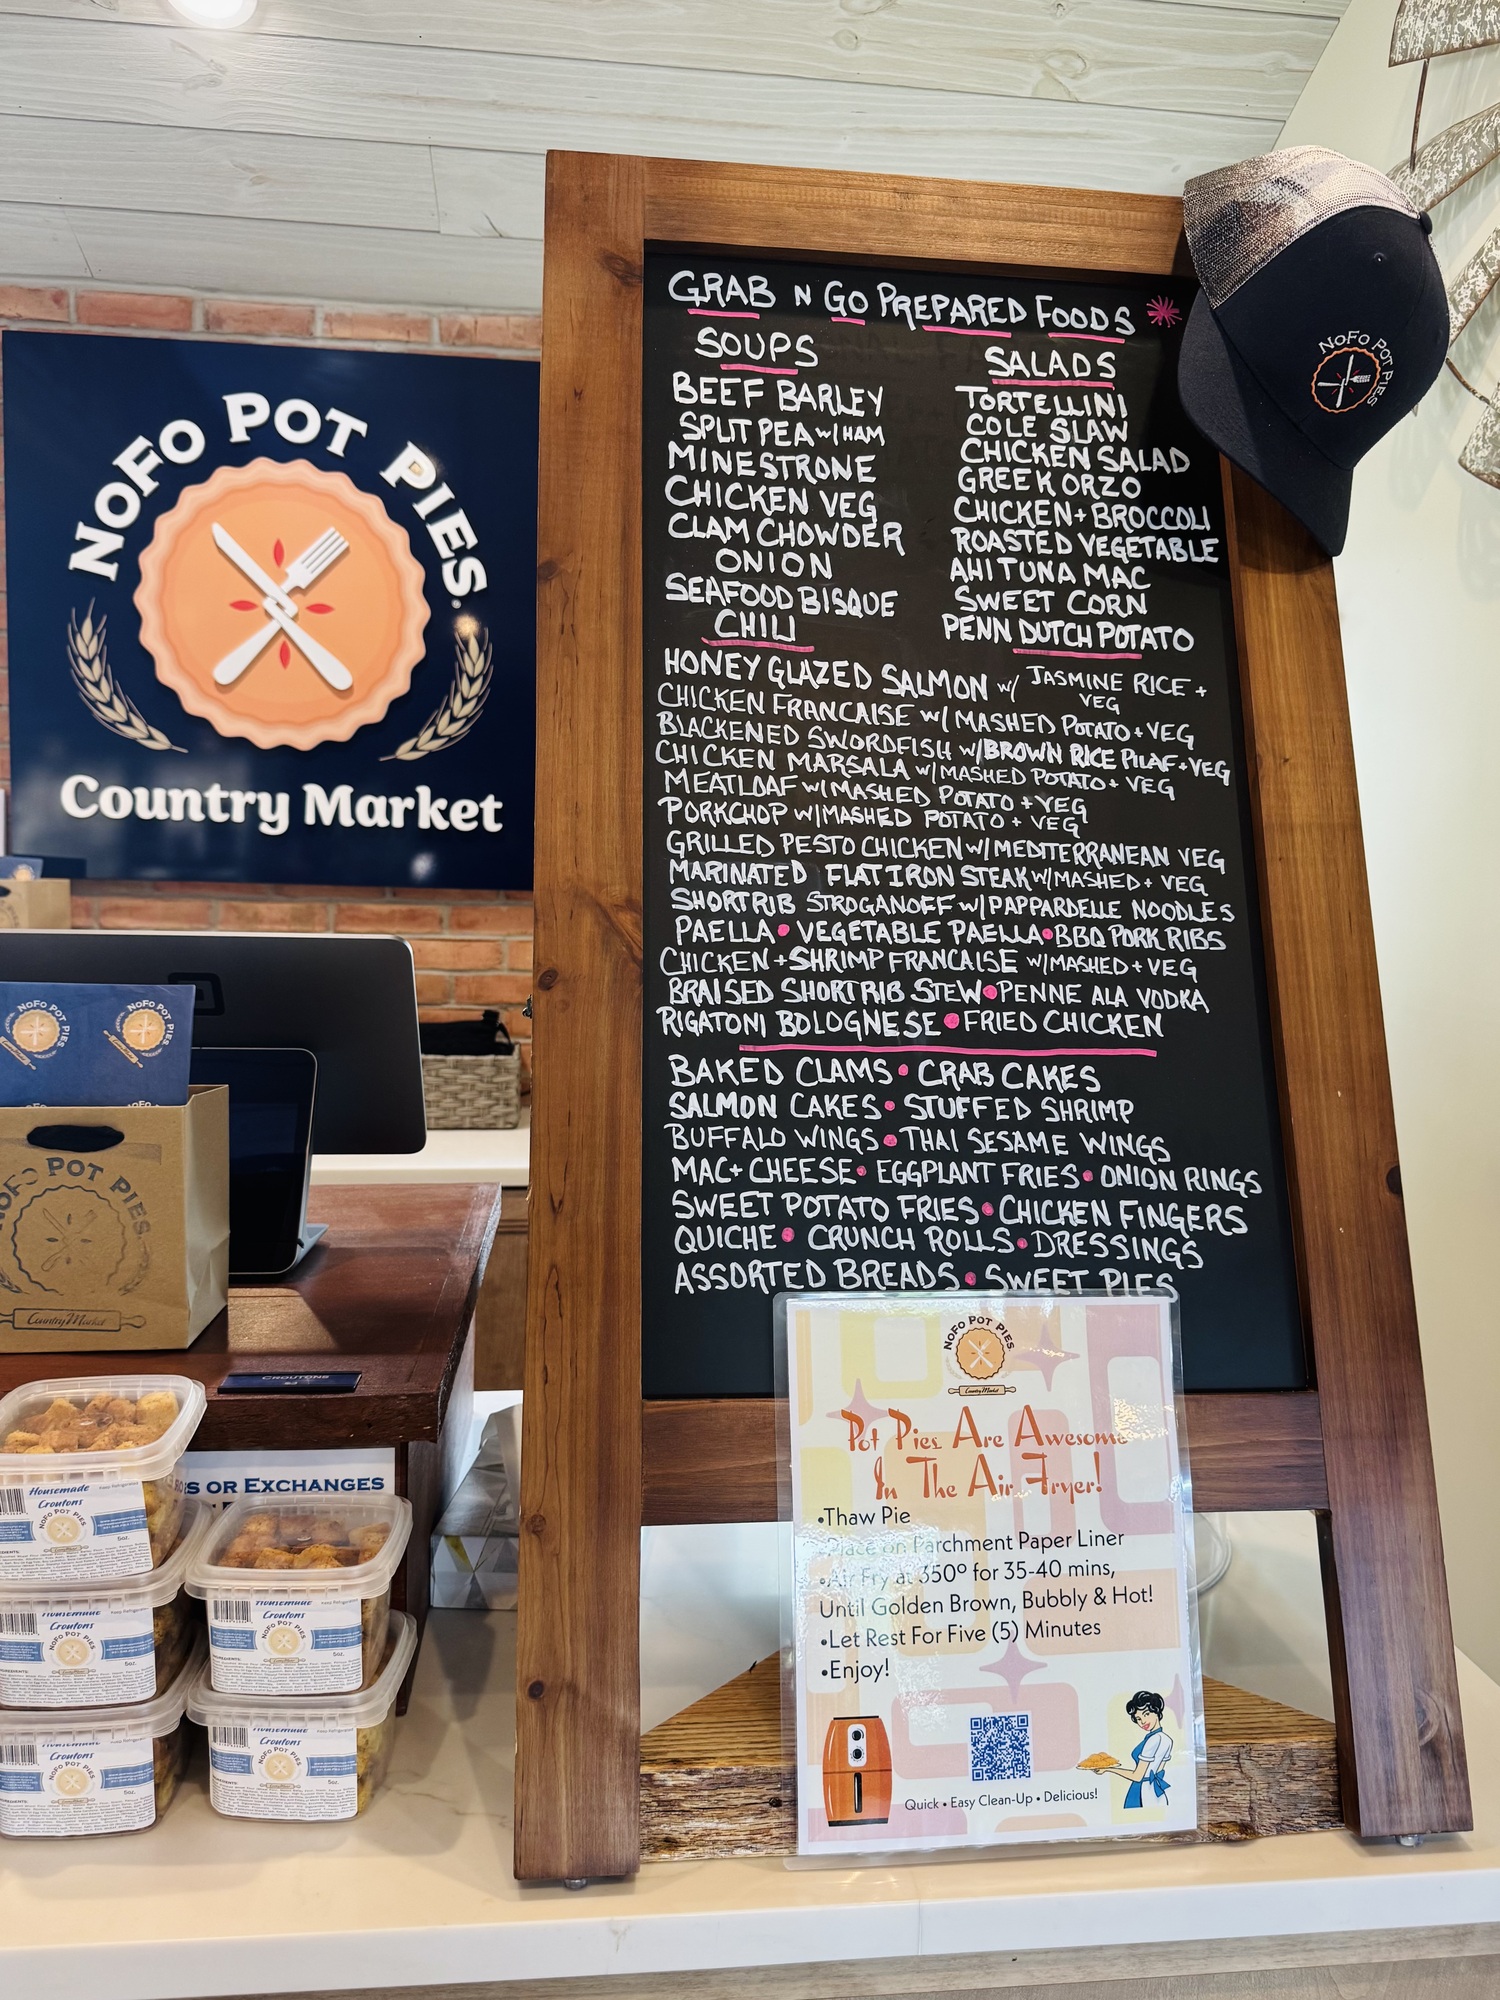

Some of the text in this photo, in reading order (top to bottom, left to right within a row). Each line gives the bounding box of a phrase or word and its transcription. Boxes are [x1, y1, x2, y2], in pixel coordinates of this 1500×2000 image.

[668, 270, 776, 308] GRAB
[824, 280, 869, 317] GO
[877, 282, 1027, 331] PREPARED
[1035, 295, 1136, 336] FOODS
[695, 326, 819, 367] SOUPS
[984, 346, 1117, 378] SALADS
[1371, 338, 1393, 367] POT
[672, 371, 883, 417] BEEF BARLEY
[955, 385, 1128, 418] TORTELLINI
[1367, 370, 1394, 407] PIES
[966, 412, 1128, 444] COLE SLAW
[668, 440, 877, 485] MINESTRONE
[960, 437, 1190, 474] CHICKEN SALAD
[221, 391, 368, 457] POT
[379, 441, 488, 598] PIES
[665, 474, 877, 523] CHICKEN VEG
[957, 466, 1142, 499] GREEK ORZO
[668, 512, 906, 556] CLAM CHOWDER
[950, 527, 1219, 564] ROASTED VEGETABLE
[715, 548, 832, 580] ONION
[950, 557, 1151, 590] AHI TUNA MAC
[665, 572, 899, 619] SEAFOOD BISQUE
[954, 585, 1148, 618] SWEET CORN
[941, 613, 1194, 652] PENN DUTCH POTATO
[664, 648, 761, 681] HONEY
[768, 655, 872, 690] GLAZED
[881, 663, 988, 702] SALMON
[1026, 666, 1123, 692] JASMINE
[1133, 673, 1192, 697] RICE
[60, 774, 503, 836] Country Market
[675, 915, 1227, 952] PAELLA VEGETABLE PAELLA BBQ PORK RIBS
[49, 1004, 67, 1022] POT
[156, 1003, 172, 1020] POT
[656, 1009, 1164, 1041] RIGATONI BOLOGNESE FRIED CHICKEN
[57, 1025, 71, 1048] PIES
[162, 1023, 175, 1046] PIES
[668, 1054, 1101, 1093] BAKED CLAMS CRAB CAKES
[663, 1123, 1171, 1165] BUFFALO WINGS THAI SESAME WINGS
[46, 1157, 104, 1181] POT
[109, 1175, 150, 1235] PIES
[674, 1224, 1204, 1270] QUICHE CRUNCH ROLLS DRESSINGS
[675, 1257, 1179, 1303] ASSORTED BREADS SWEET PIES
[968, 1315, 993, 1326] POT
[840, 1408, 880, 1452] Pot
[888, 1408, 943, 1450] Pies
[952, 1405, 1004, 1449] Are
[29, 1484, 90, 1496] Housemade
[874, 1451, 1103, 1504] In The Air Fryer!
[38, 1498, 84, 1509] Croutons
[72, 1511, 87, 1527] PIES
[882, 1506, 911, 1524] Pie
[883, 1541, 907, 1555] on
[913, 1533, 1013, 1555] Parchment
[1018, 1531, 1072, 1554] Paper
[1077, 1529, 1125, 1547] Liner
[861, 1566, 889, 1591] Fry
[896, 1573, 913, 1585] at
[973, 1562, 999, 1581] for
[1004, 1559, 1062, 1580] 35-40
[1068, 1559, 1116, 1579] mins,
[262, 1610, 306, 1619] Croutons
[819, 1584, 1153, 1618] Until Golden Brown, Bubbly & Hot!
[49, 1622, 95, 1631] Croutons
[84, 1635, 96, 1650] PIES
[294, 1625, 306, 1640] PIES
[866, 1628, 906, 1647] Rest
[912, 1626, 942, 1644] For
[948, 1624, 986, 1643] Five
[992, 1620, 1019, 1643] (5)
[1025, 1620, 1101, 1639] Minutes
[49, 1752, 95, 1761] Croutons
[260, 1737, 302, 1746] Croutons
[905, 1787, 1098, 1811] Quick Easy Clean-Up Delicious!
